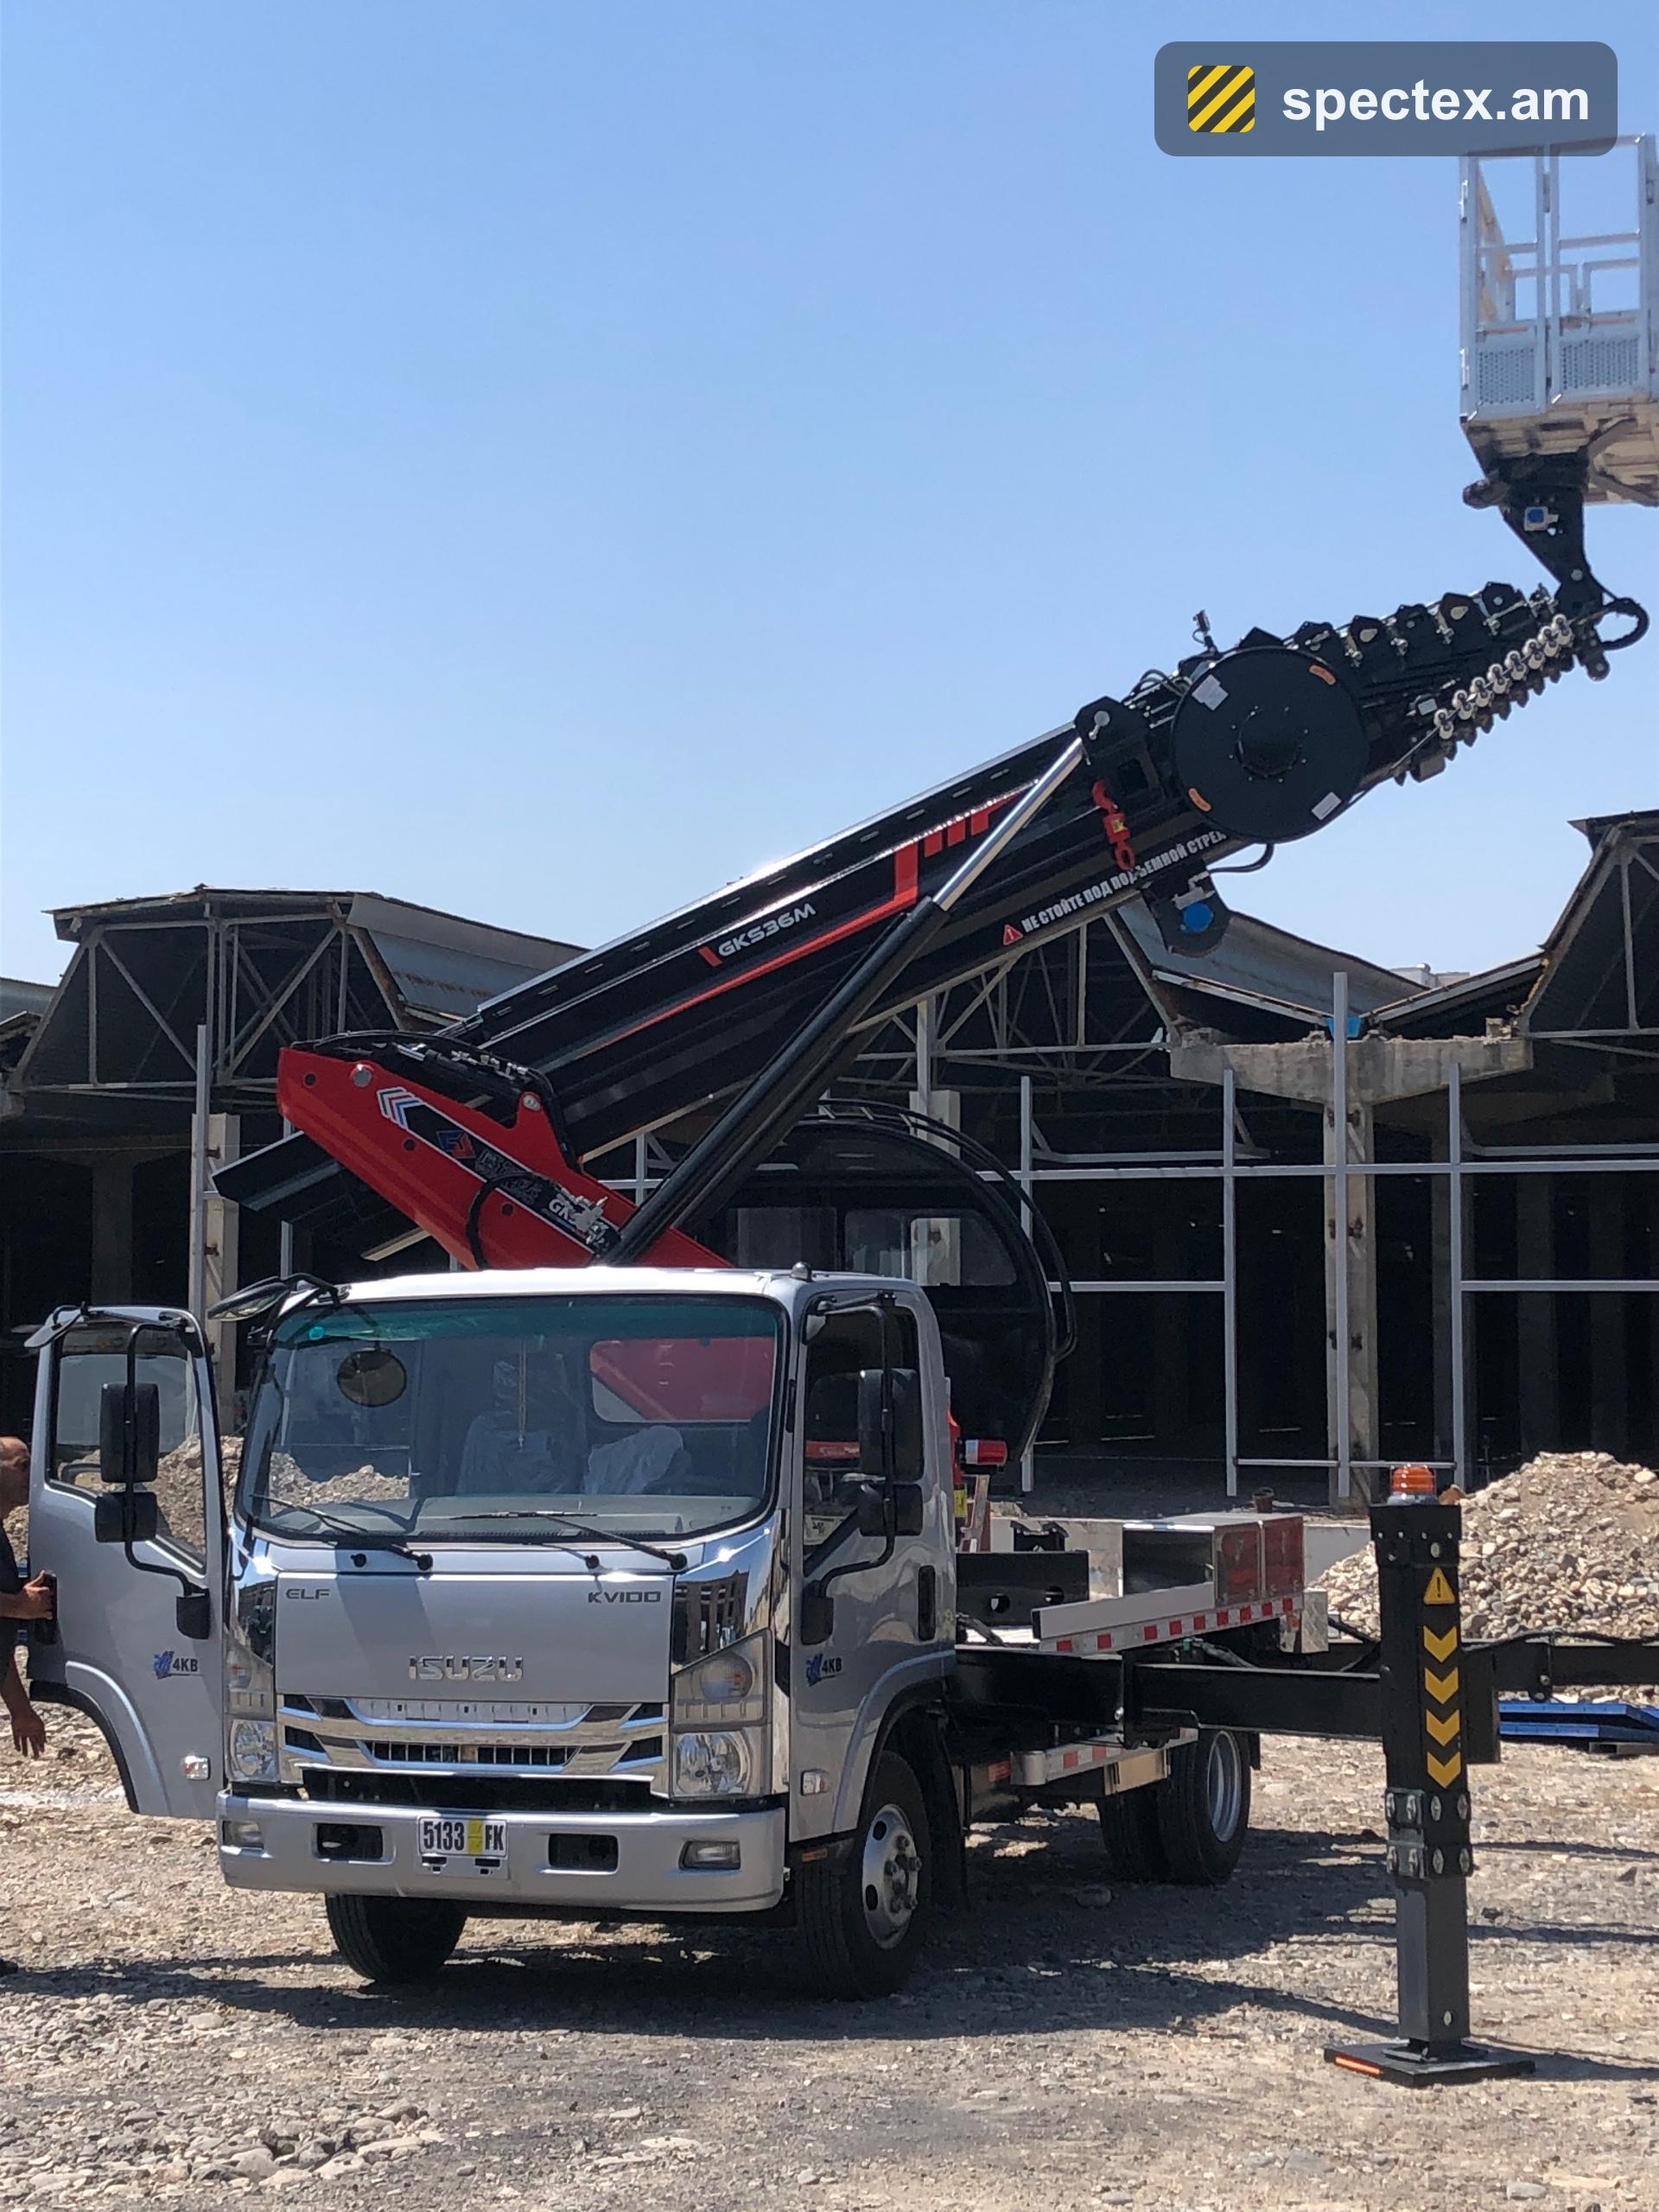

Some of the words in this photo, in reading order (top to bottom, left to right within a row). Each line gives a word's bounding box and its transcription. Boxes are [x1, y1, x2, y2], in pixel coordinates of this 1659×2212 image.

[1021, 912, 1040, 933] НЕ
[1036, 892, 1085, 925] СТОЙТЕ
[1082, 881, 1113, 904] ПОД
[718, 903, 817, 957] GKS36M
[285, 1588, 330, 1600] ELF
[409, 1655, 523, 1681] ISUZU
[423, 1821, 465, 1851] 5133
[485, 1824, 504, 1851] FK
